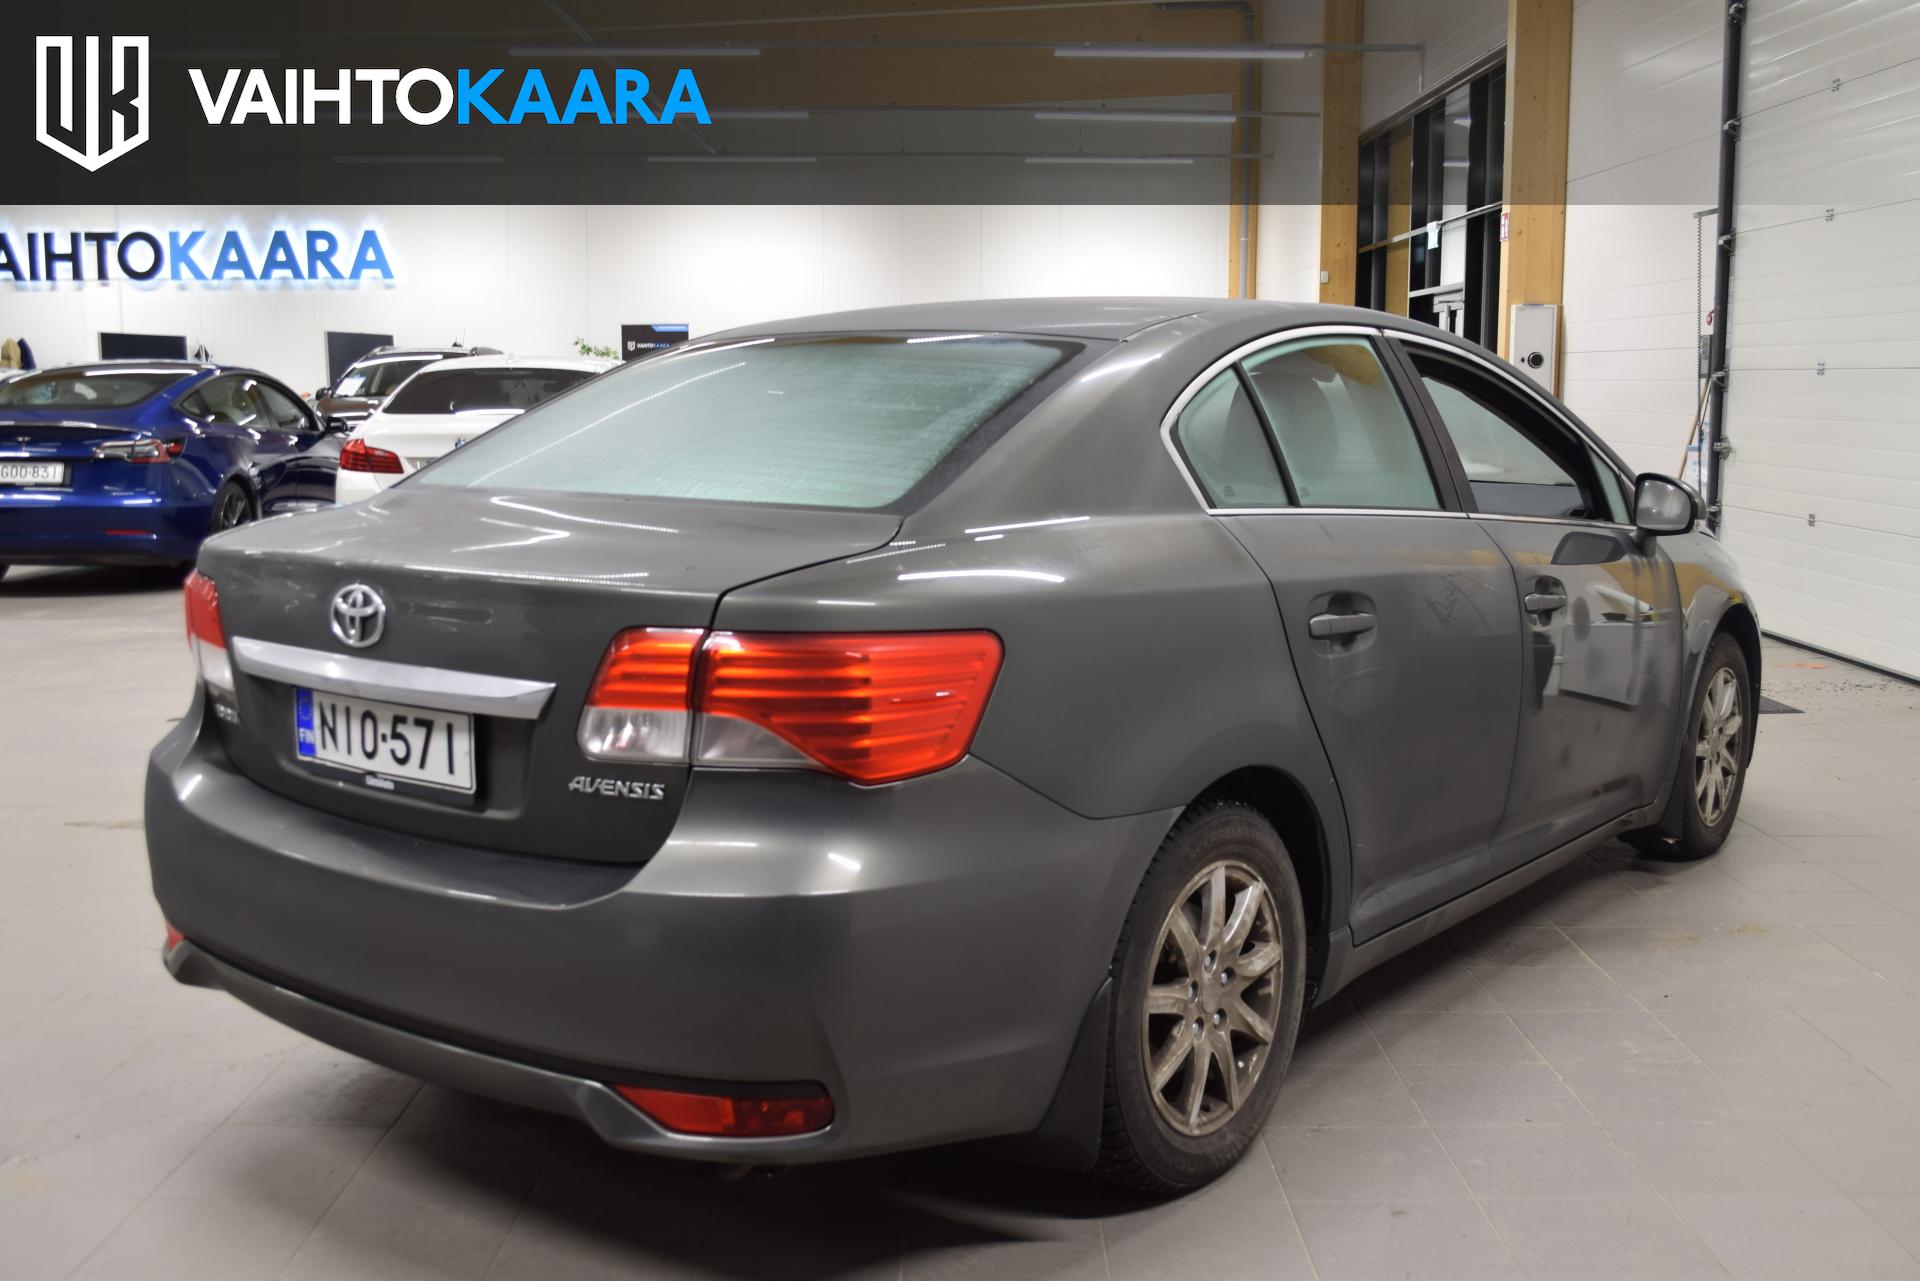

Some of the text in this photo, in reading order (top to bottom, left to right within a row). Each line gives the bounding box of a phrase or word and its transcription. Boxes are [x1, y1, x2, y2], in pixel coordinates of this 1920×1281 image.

[299, 727, 315, 745] FIN
[319, 701, 454, 775] NIO-571
[568, 776, 665, 800] AVENSIS
